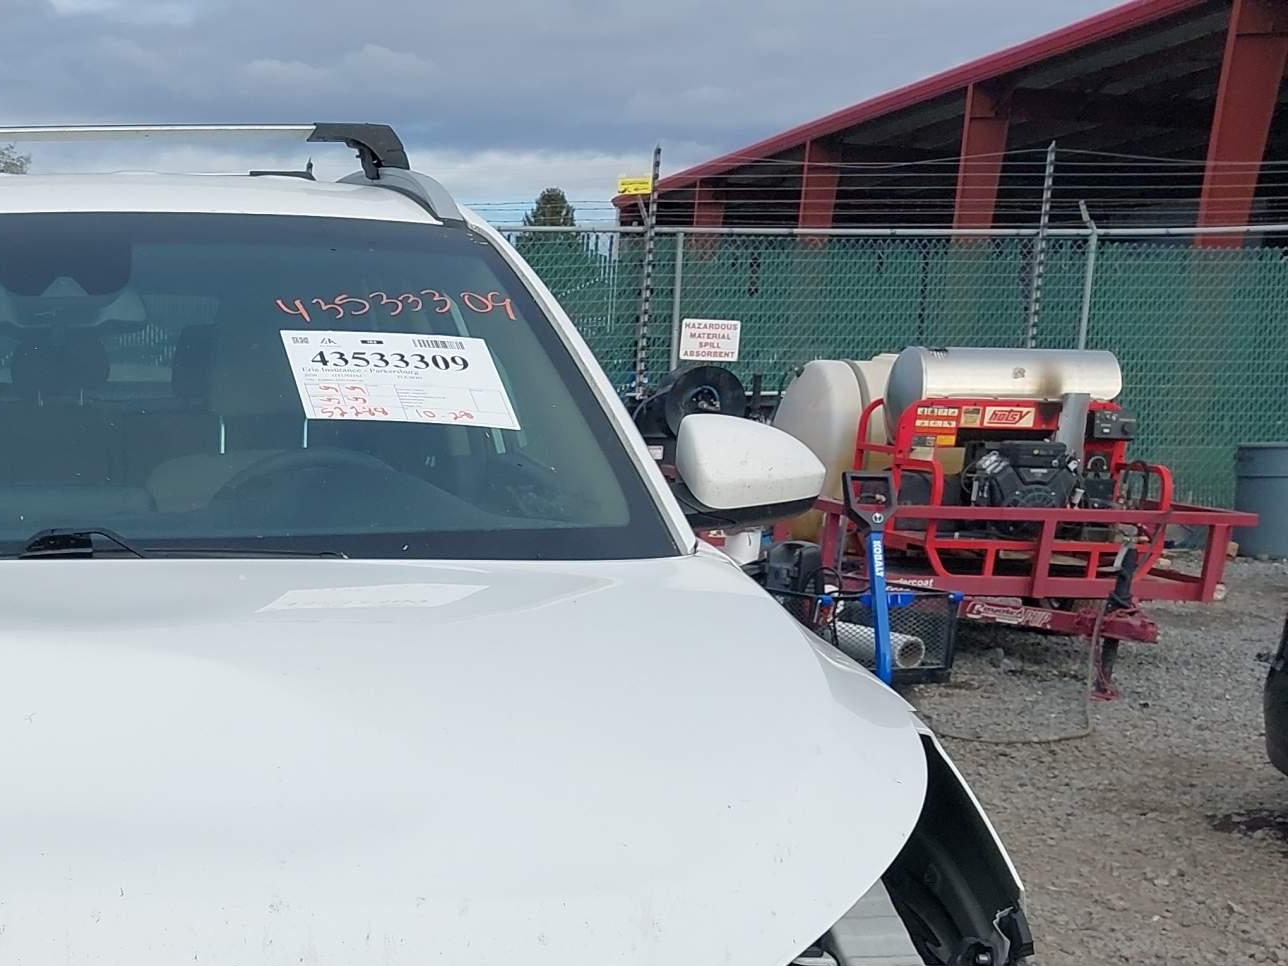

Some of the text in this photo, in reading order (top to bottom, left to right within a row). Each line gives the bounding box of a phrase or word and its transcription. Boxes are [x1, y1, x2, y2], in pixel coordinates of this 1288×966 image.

[684, 322, 738, 331] HAZARDOUS
[689, 332, 731, 340] MATERIAL
[698, 341, 721, 349] SPILL
[683, 350, 736, 358] ABSORBENT
[311, 350, 470, 372] 43533309
[872, 540, 885, 577] KOBALT
